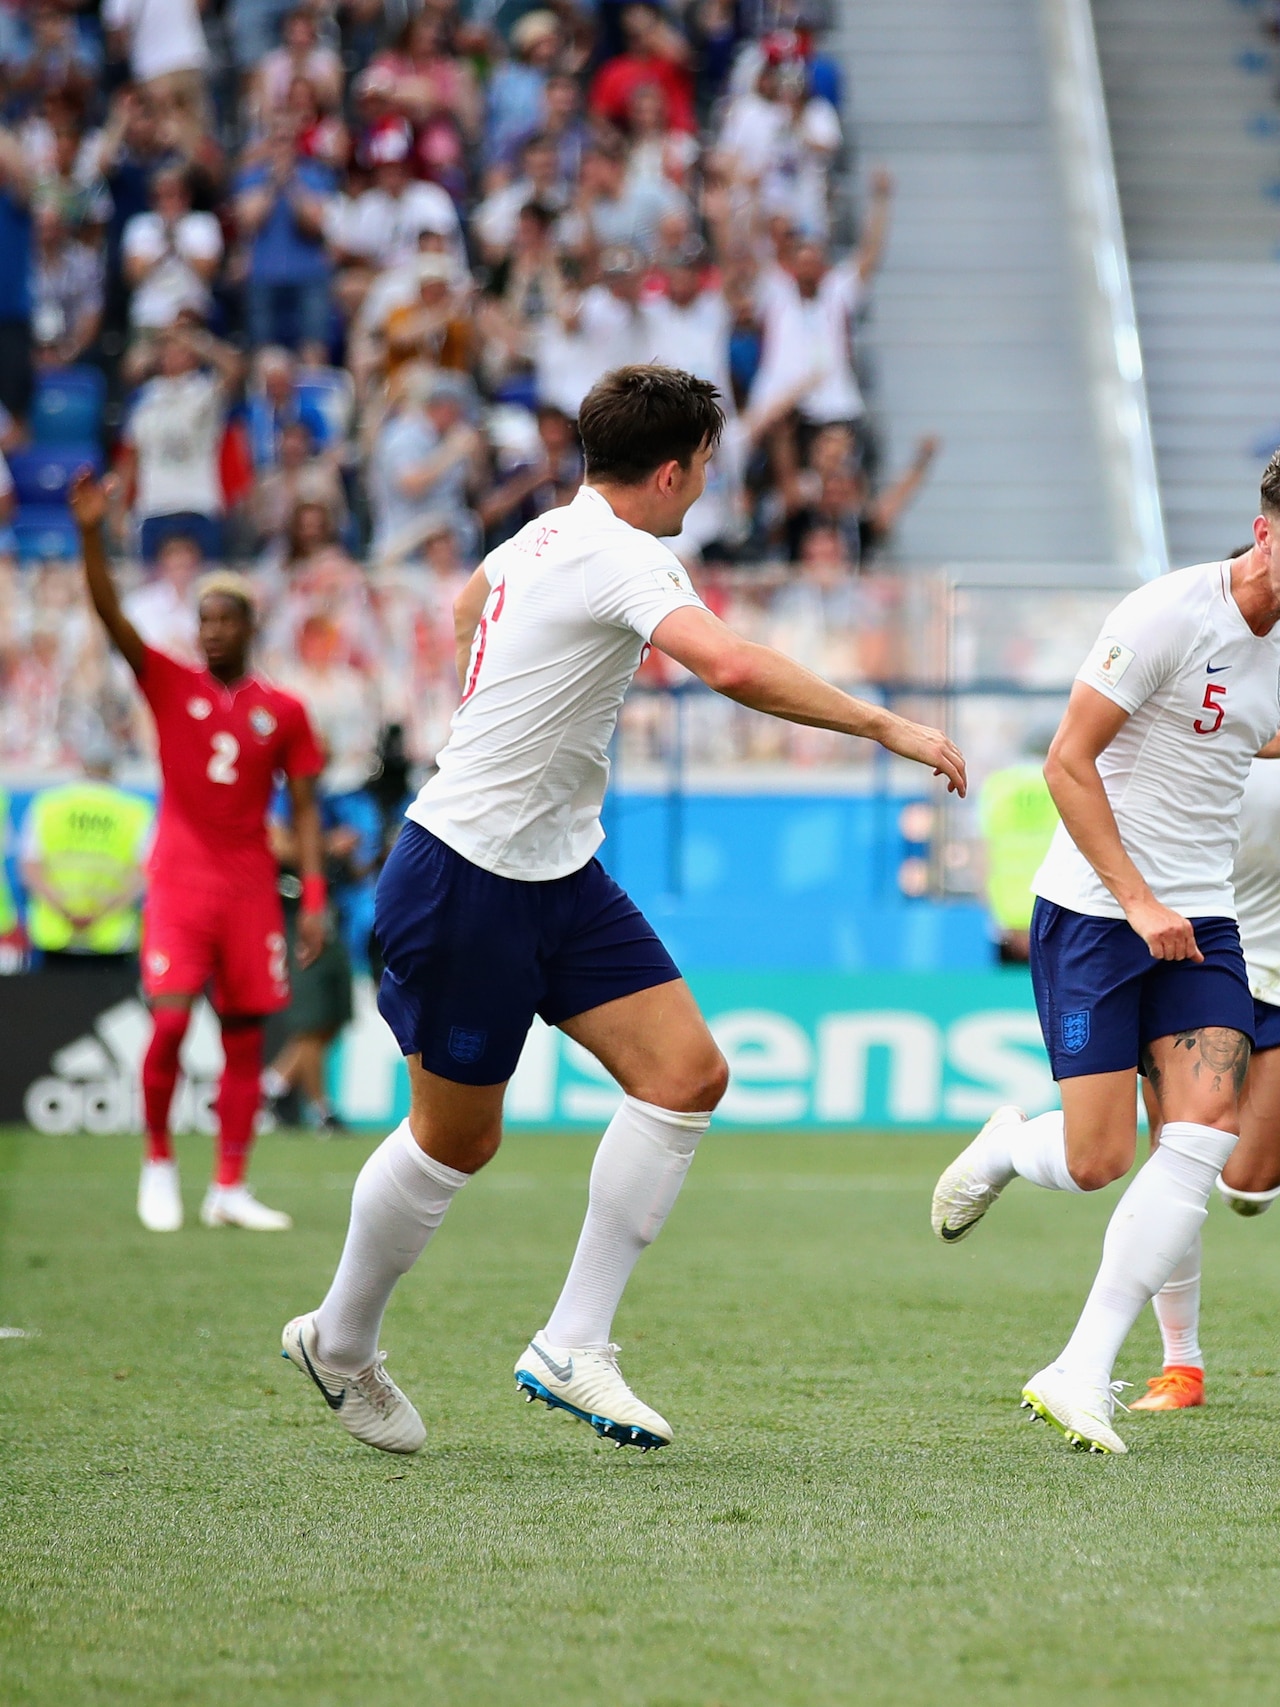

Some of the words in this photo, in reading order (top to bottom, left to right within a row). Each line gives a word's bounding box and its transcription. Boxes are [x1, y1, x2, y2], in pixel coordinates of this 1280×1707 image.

[1193, 683, 1227, 735] 5
[206, 731, 241, 785] 2
[323, 972, 1057, 1122] Hisens
